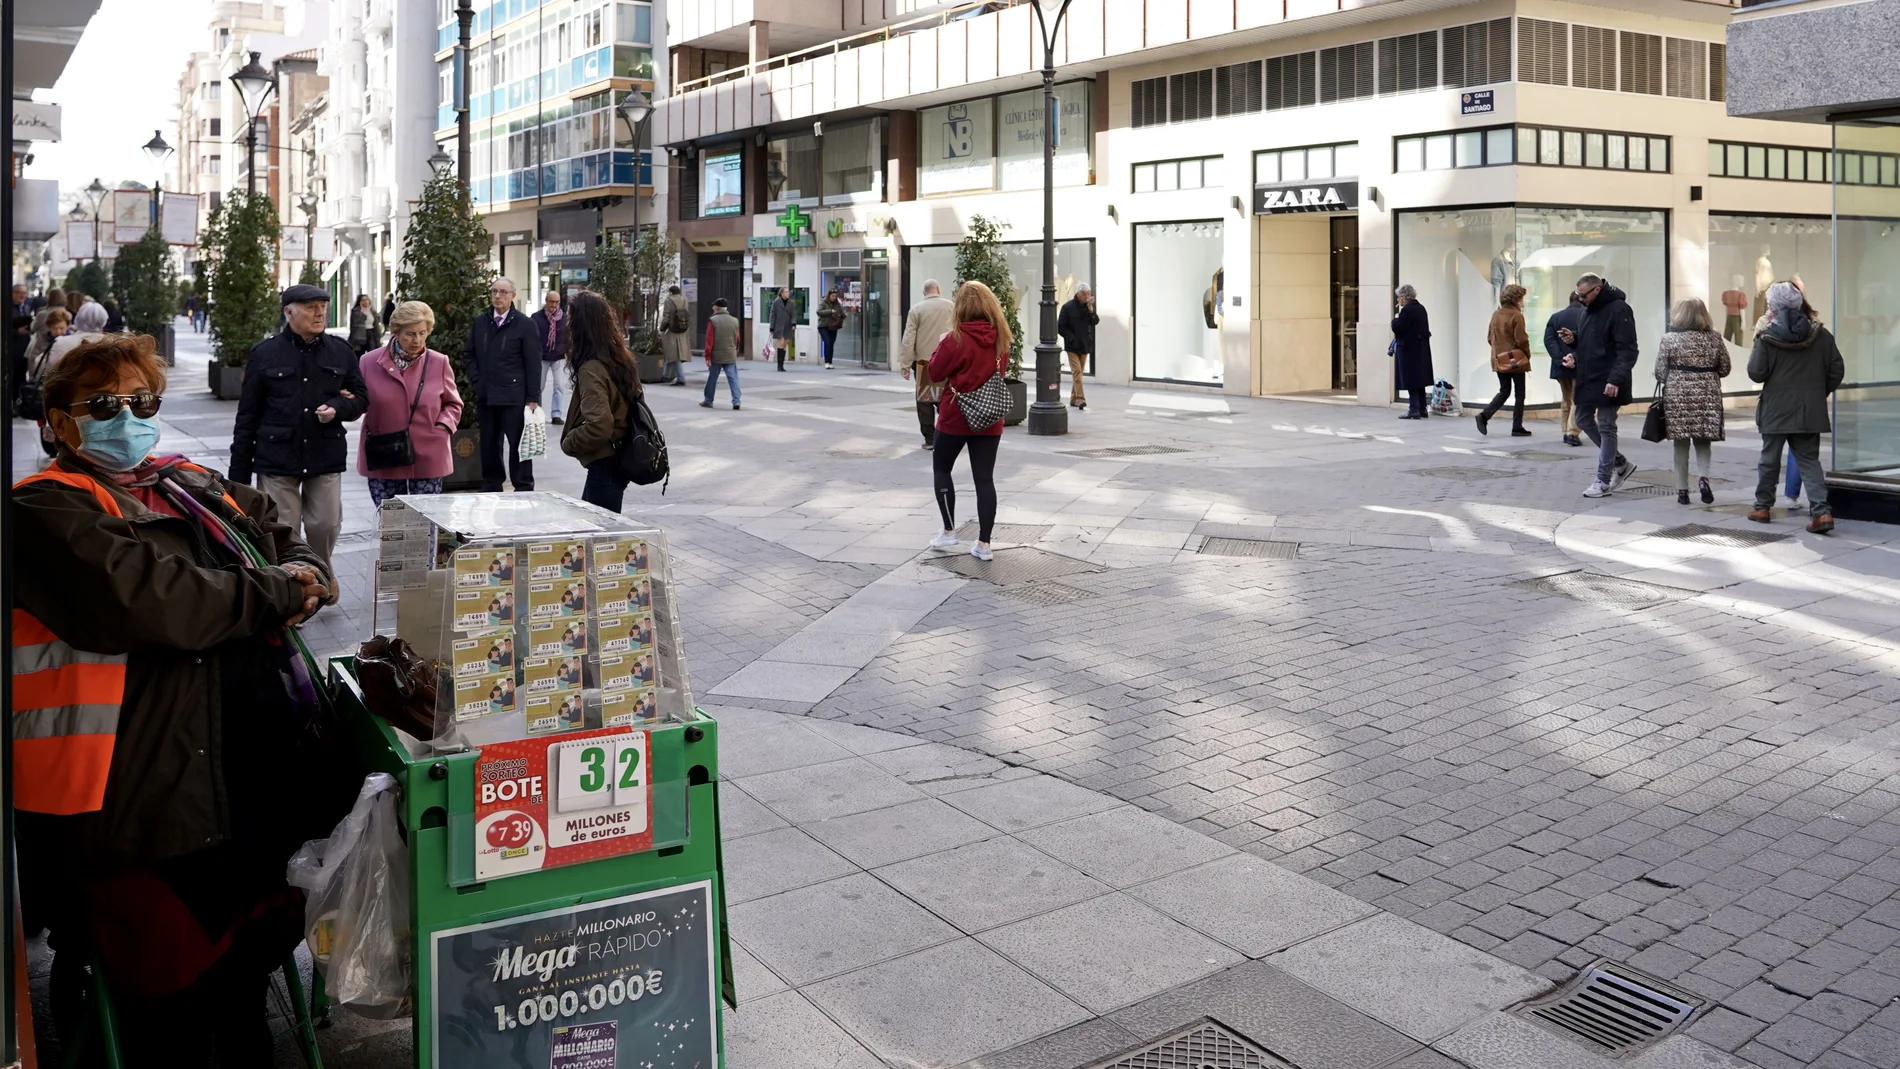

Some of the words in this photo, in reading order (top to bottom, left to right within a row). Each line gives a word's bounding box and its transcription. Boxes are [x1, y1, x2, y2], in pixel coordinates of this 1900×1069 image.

[1006, 109, 1027, 125] CLÍNICA
[1029, 101, 1081, 122] ESTOÓGICA
[1464, 104, 1491, 113] SANTIAGO
[1264, 187, 1344, 208] ZARA
[543, 241, 564, 256] Phone
[564, 240, 585, 255] House
[481, 758, 528, 772] PRÓXIMO
[481, 767, 528, 783] SORTEO
[481, 776, 542, 804] BOTE
[531, 795, 543, 805] DE
[499, 827, 508, 841] 7
[511, 820, 531, 841] 39
[565, 811, 631, 832] MILLONES
[570, 830, 586, 843] de
[591, 825, 626, 839] euros
[508, 848, 526, 856] ONCE
[534, 930, 574, 944] HAZTE
[576, 911, 656, 937] MILLONARIO
[493, 945, 576, 982] Mega
[588, 930, 662, 961] RÁPIDO
[518, 986, 545, 995] GANA
[564, 971, 609, 986] INSTANTE
[612, 964, 640, 975] HASTA
[494, 970, 663, 1031] 1.000.000€
[572, 1027, 600, 1040] Mega
[553, 1037, 614, 1058] MILLONARIO
